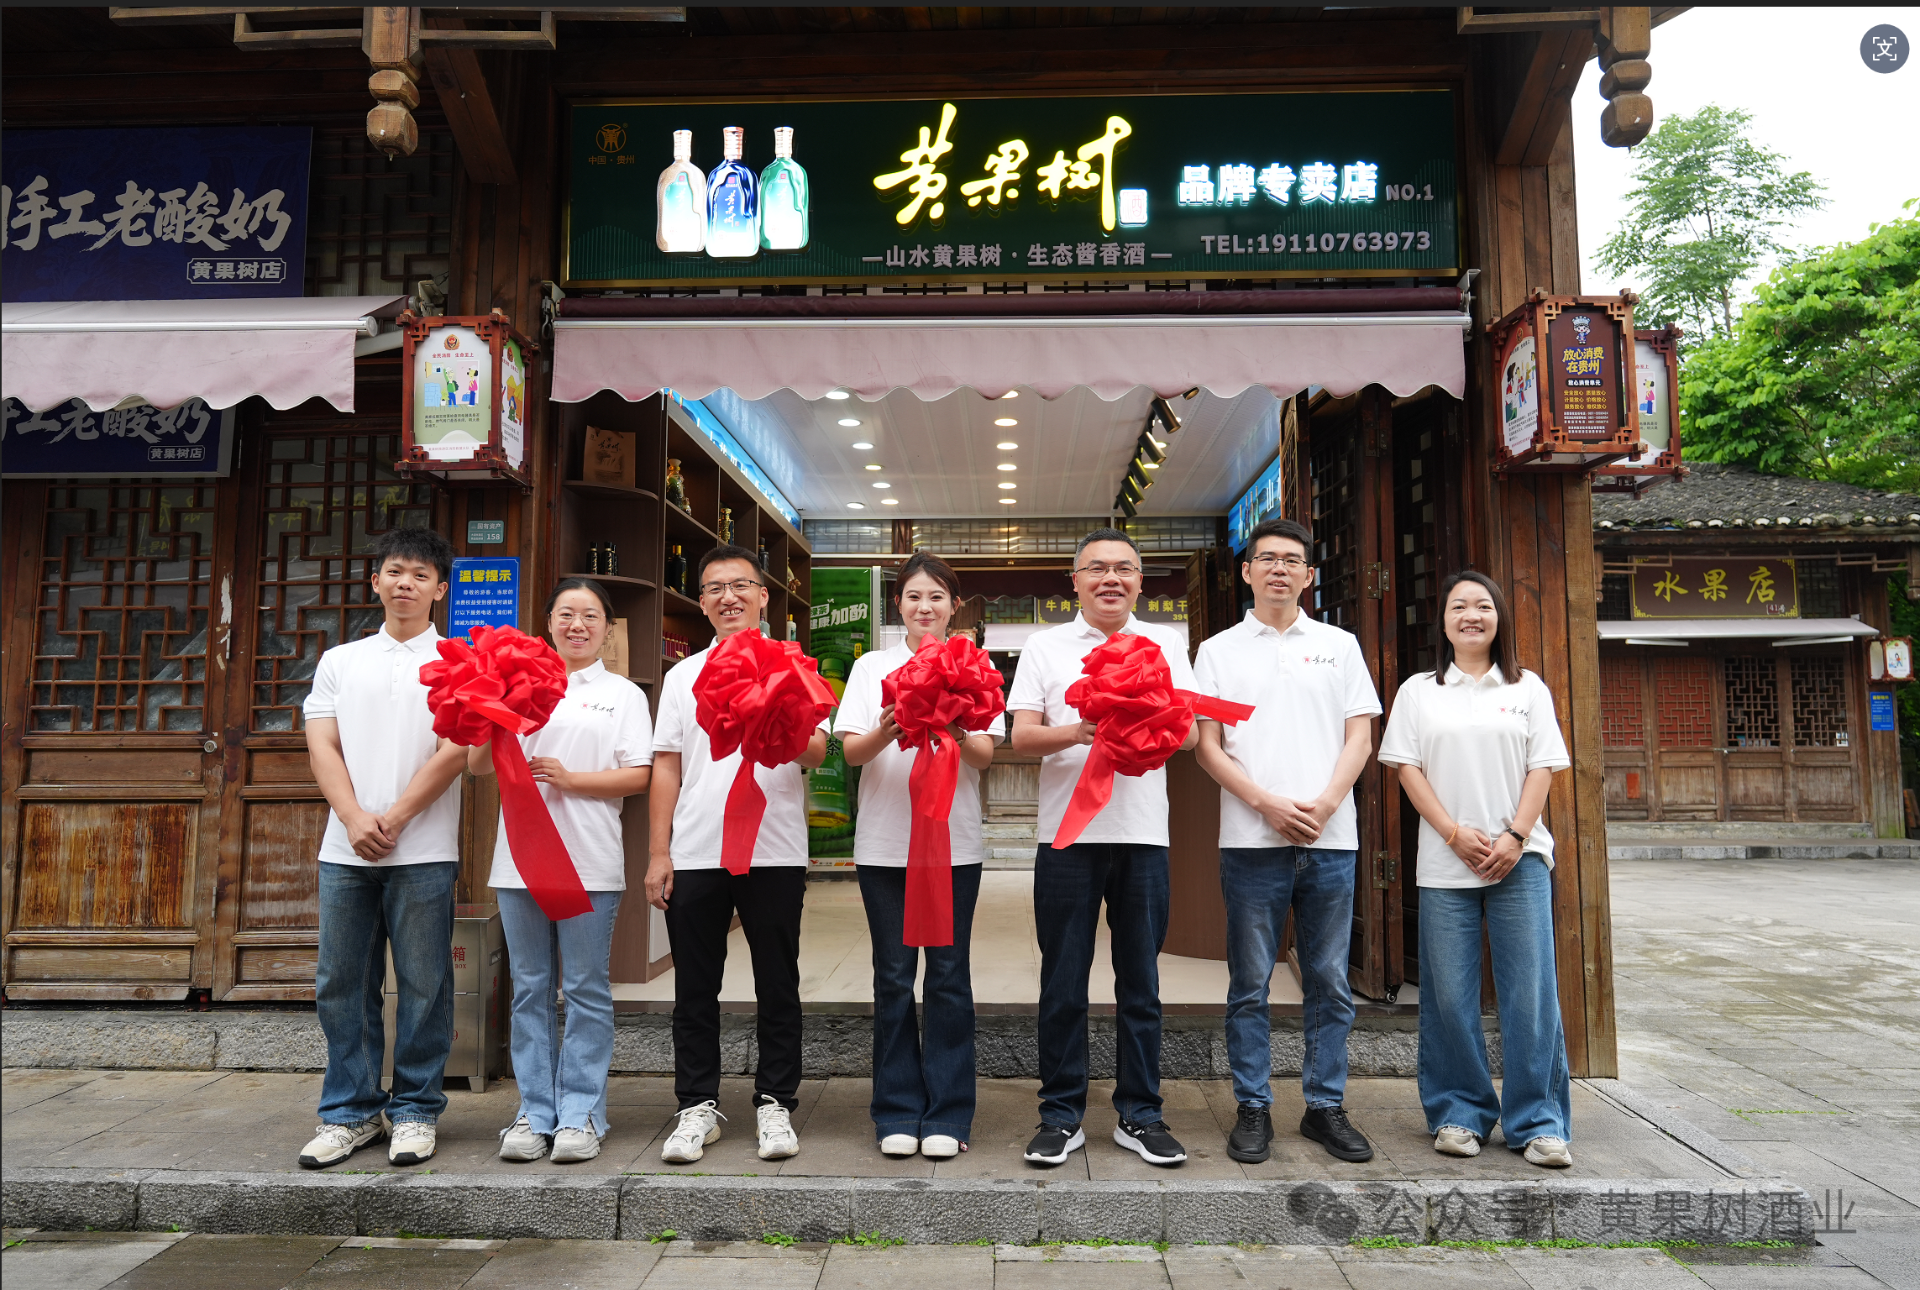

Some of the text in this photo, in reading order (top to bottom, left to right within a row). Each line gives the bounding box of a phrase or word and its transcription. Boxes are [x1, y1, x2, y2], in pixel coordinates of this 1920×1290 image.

[588, 154, 635, 165] 中国·贵州
[873, 102, 1133, 231] 黄果树
[1178, 161, 1379, 206] 品牌专卖店
[1386, 183, 1434, 201] NO.1
[2, 175, 292, 252] 手工老酸奶
[1201, 231, 1431, 255] TEL:19110763973
[191, 261, 284, 281] 黄果树店
[1563, 346, 1604, 362] 放心消费
[1566, 359, 1600, 375] 在贵州
[150, 447, 203, 460] 黄果树店
[459, 569, 512, 582] 温馨提示
[1653, 566, 1777, 605] 水果店
[1148, 600, 1188, 612] 刺梨干
[826, 738, 841, 756] 茶
